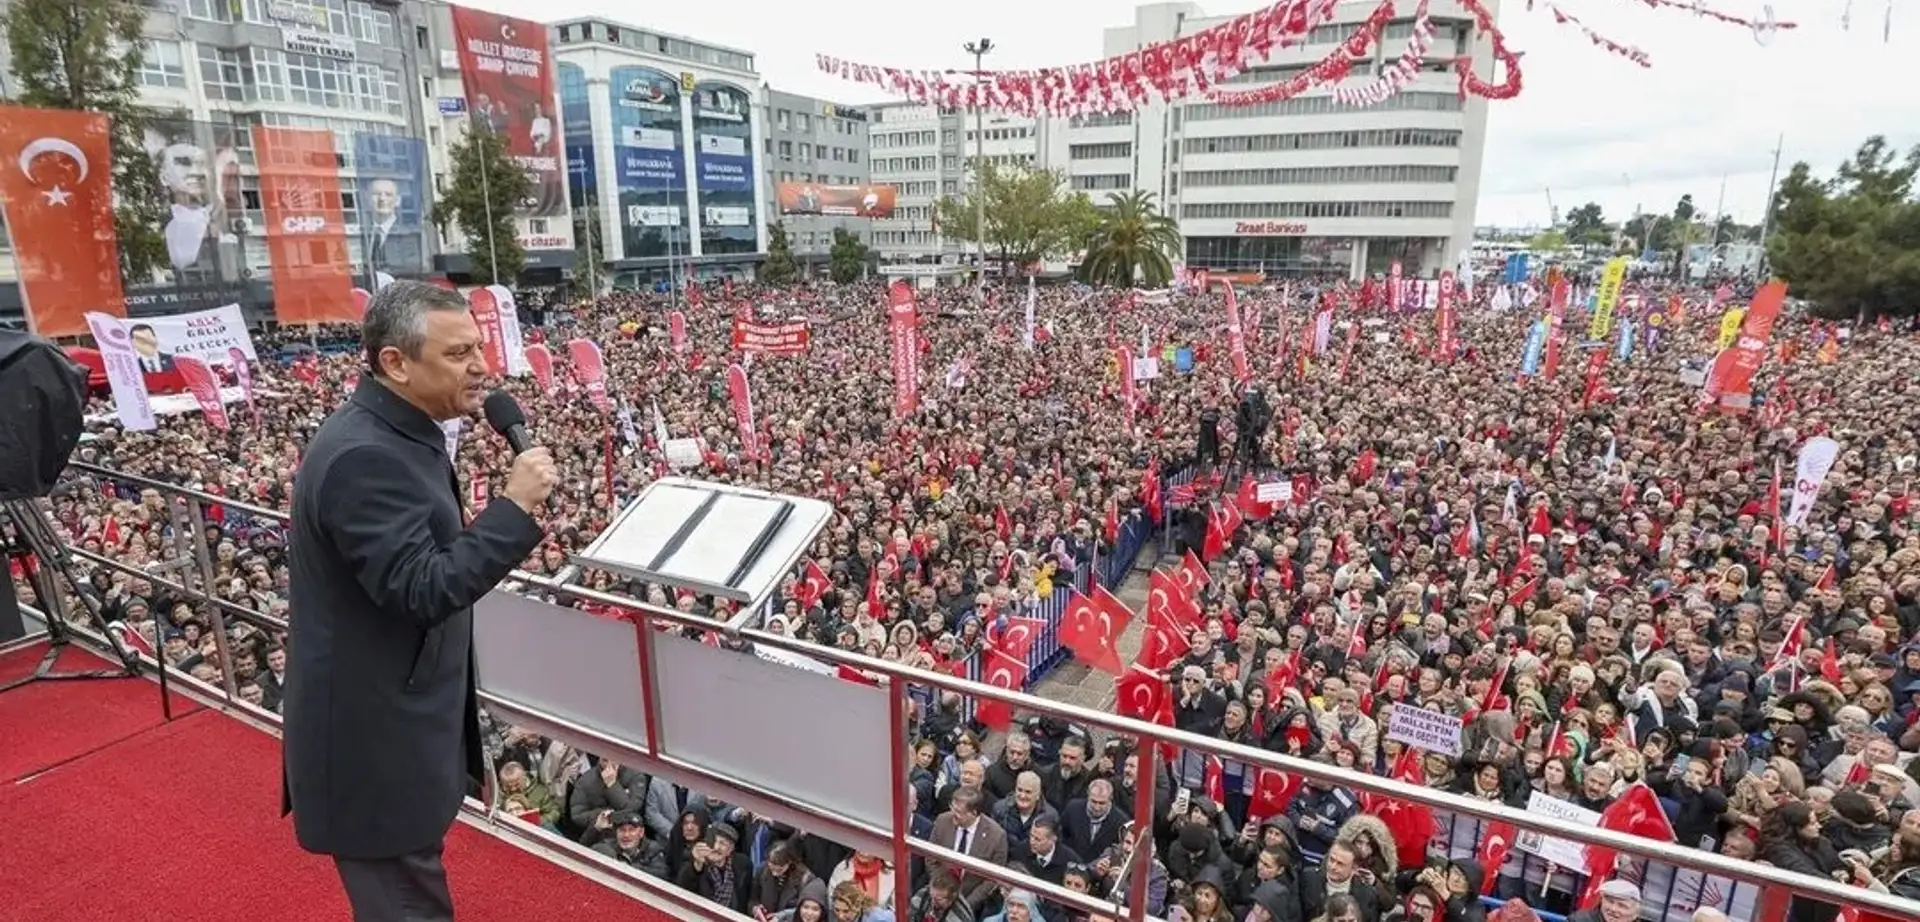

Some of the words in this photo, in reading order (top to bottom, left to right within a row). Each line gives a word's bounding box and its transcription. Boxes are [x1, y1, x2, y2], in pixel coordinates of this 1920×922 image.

[281, 215, 325, 234] CHP
[1235, 221, 1265, 233] Ziraat
[1267, 221, 1308, 233] Bankası
